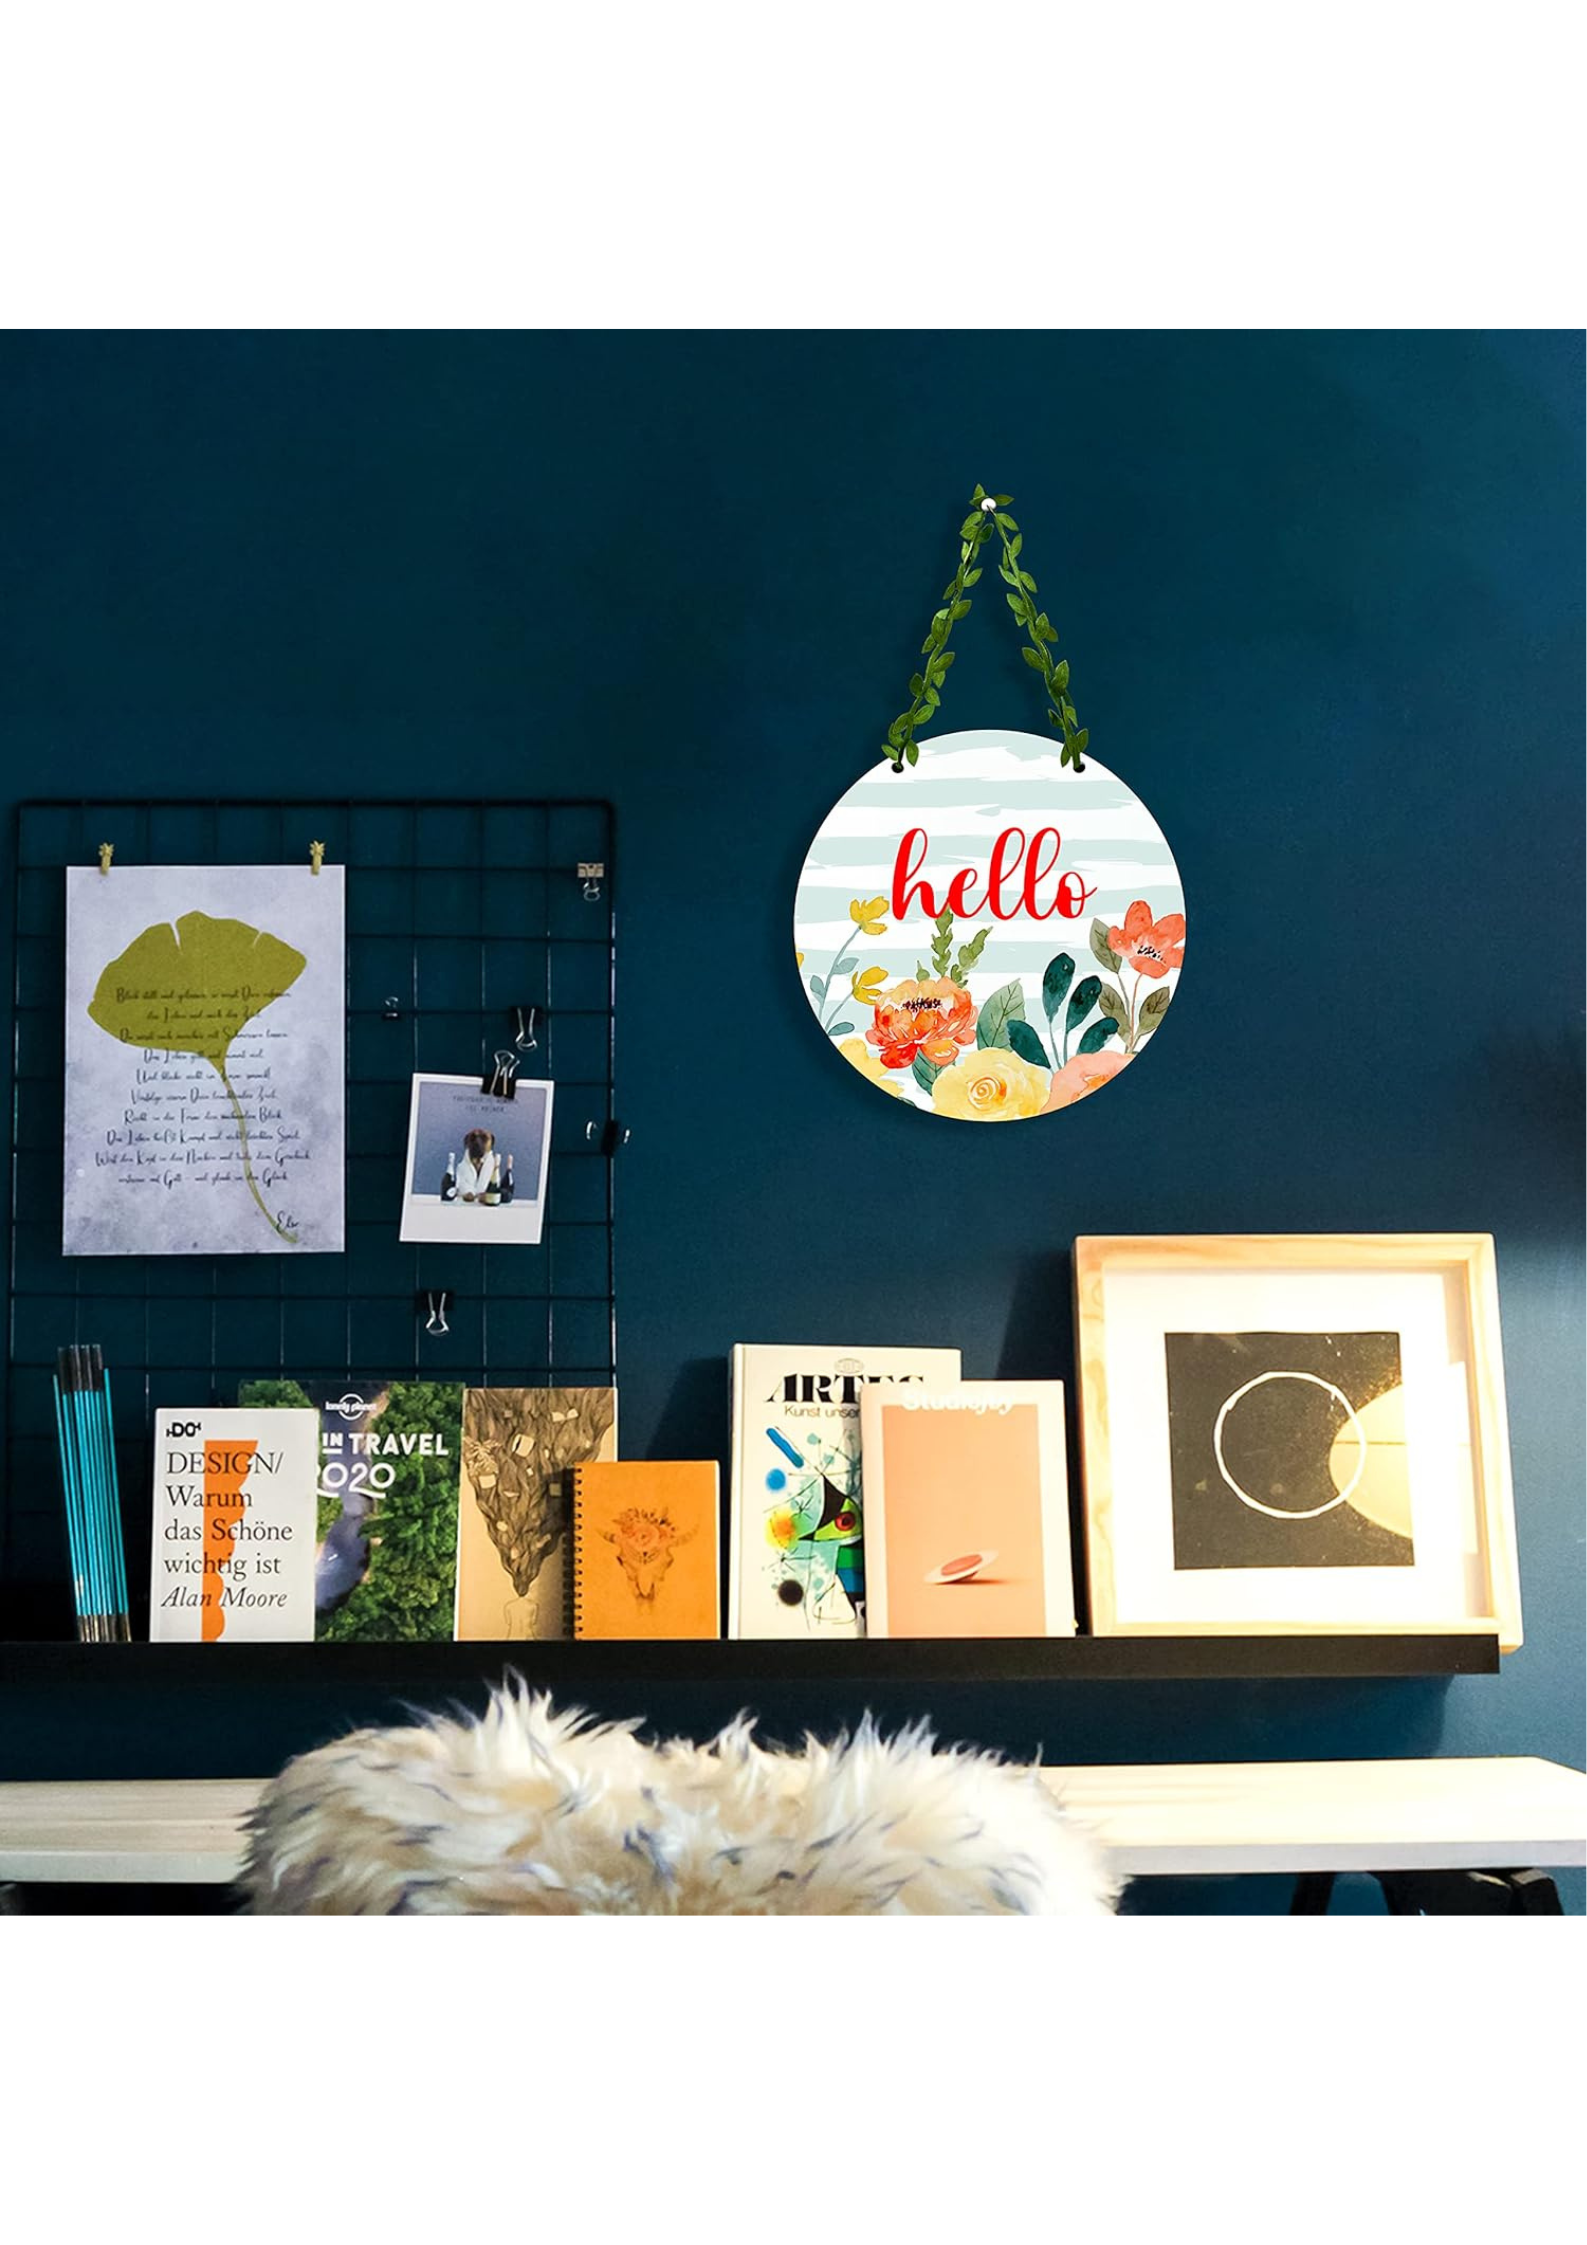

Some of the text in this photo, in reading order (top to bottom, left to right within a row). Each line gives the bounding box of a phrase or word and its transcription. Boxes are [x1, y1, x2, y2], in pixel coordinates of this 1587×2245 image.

[891, 827, 1098, 920] hello
[765, 1373, 924, 1404] ART
[325, 1401, 377, 1414] lonely planet
[784, 1404, 821, 1418] Kunst
[322, 1432, 449, 1456] IN TRAVEL
[166, 1451, 284, 1475] DESIGN/
[317, 1461, 396, 1499] 020
[165, 1484, 253, 1508] Warum
[164, 1517, 294, 1541] das Schöne
[163, 1551, 282, 1583] wichtig ist
[161, 1585, 288, 1608] Alan Moore
